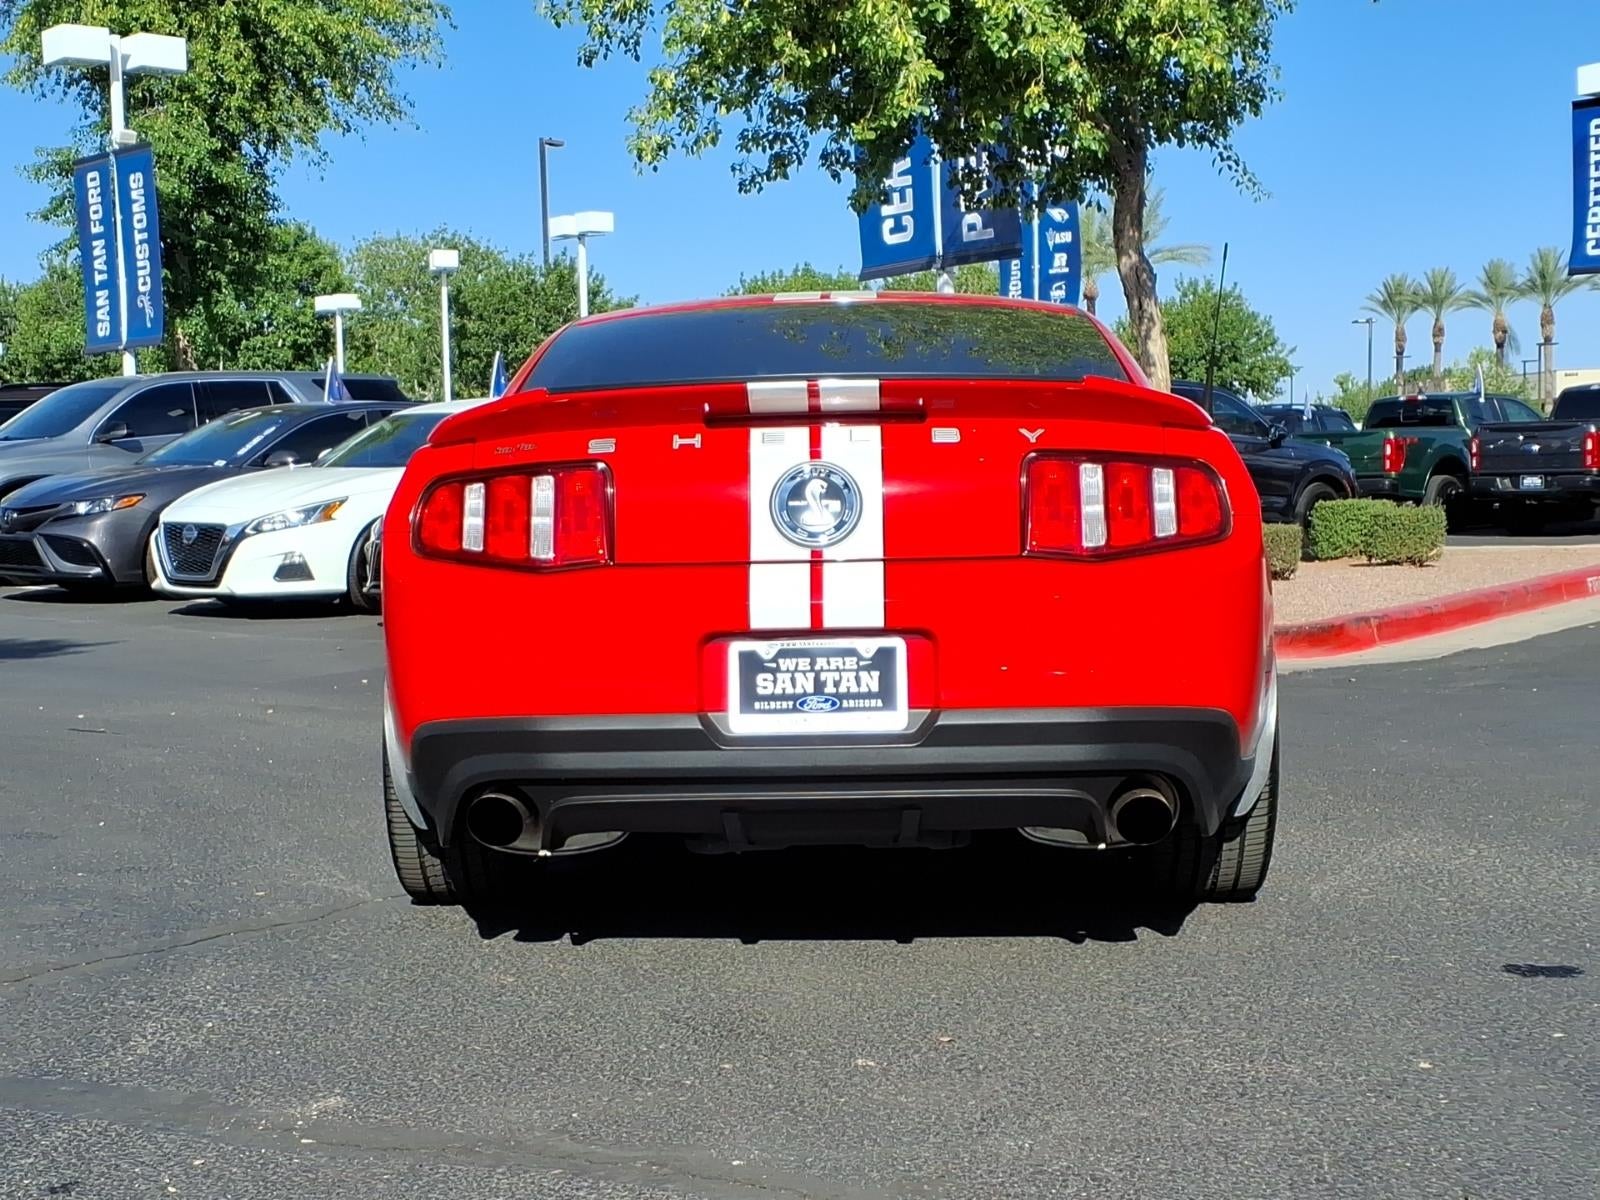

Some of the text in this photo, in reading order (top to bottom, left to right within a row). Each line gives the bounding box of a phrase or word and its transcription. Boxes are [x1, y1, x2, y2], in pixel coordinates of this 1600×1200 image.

[129, 171, 151, 293] CUSTOMS
[1055, 231, 1072, 244] ASU
[86, 170, 111, 338] SAN TAN FORD
[1008, 260, 1022, 299] ROUD
[778, 657, 858, 671] WE ARE
[755, 671, 881, 695] SAN TAN
[842, 699, 883, 708] ARIZONA
